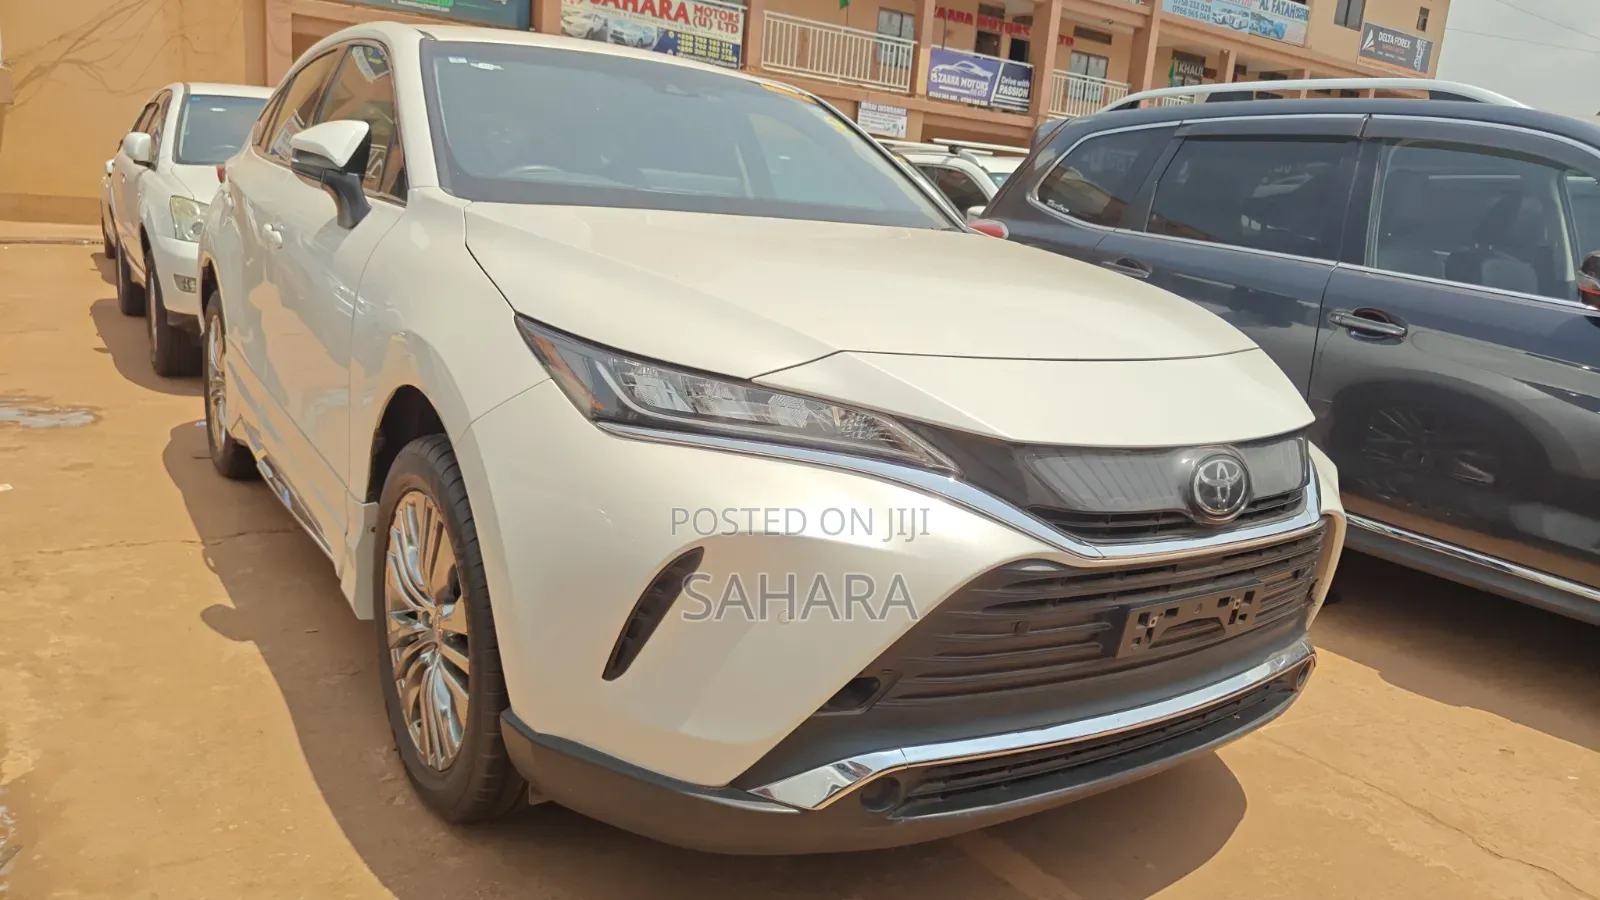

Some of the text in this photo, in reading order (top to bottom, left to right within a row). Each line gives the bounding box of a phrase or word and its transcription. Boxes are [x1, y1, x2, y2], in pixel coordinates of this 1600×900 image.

[590, 0, 690, 24] HARA
[692, 5, 740, 24] MOTORS
[1271, 0, 1296, 18] FATAH
[717, 20, 739, 34] LTD
[976, 14, 1031, 37] MOTORS
[1378, 32, 1394, 44] DELTA
[1394, 36, 1412, 49] FOREX
[960, 77, 989, 91] MOTORS
[1001, 76, 1030, 88] Drive with
[999, 84, 1029, 98] PASSION
